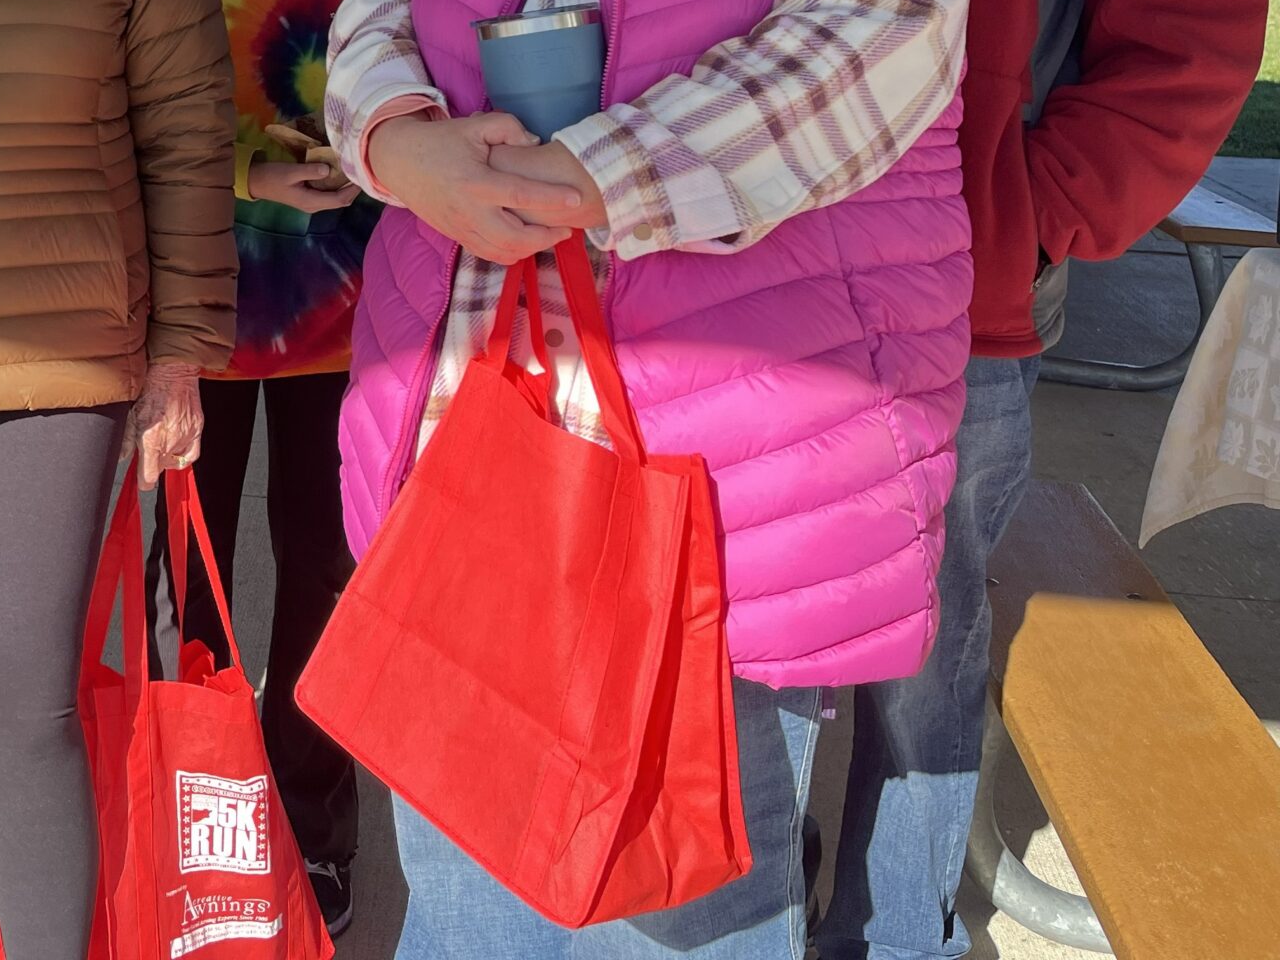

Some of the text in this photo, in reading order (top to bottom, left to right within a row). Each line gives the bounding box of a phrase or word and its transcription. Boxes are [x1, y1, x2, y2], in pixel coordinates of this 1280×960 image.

[218, 796, 257, 832] 5K
[191, 824, 258, 862] RUN
[181, 890, 268, 926] Awnings
[193, 895, 233, 906] creative
